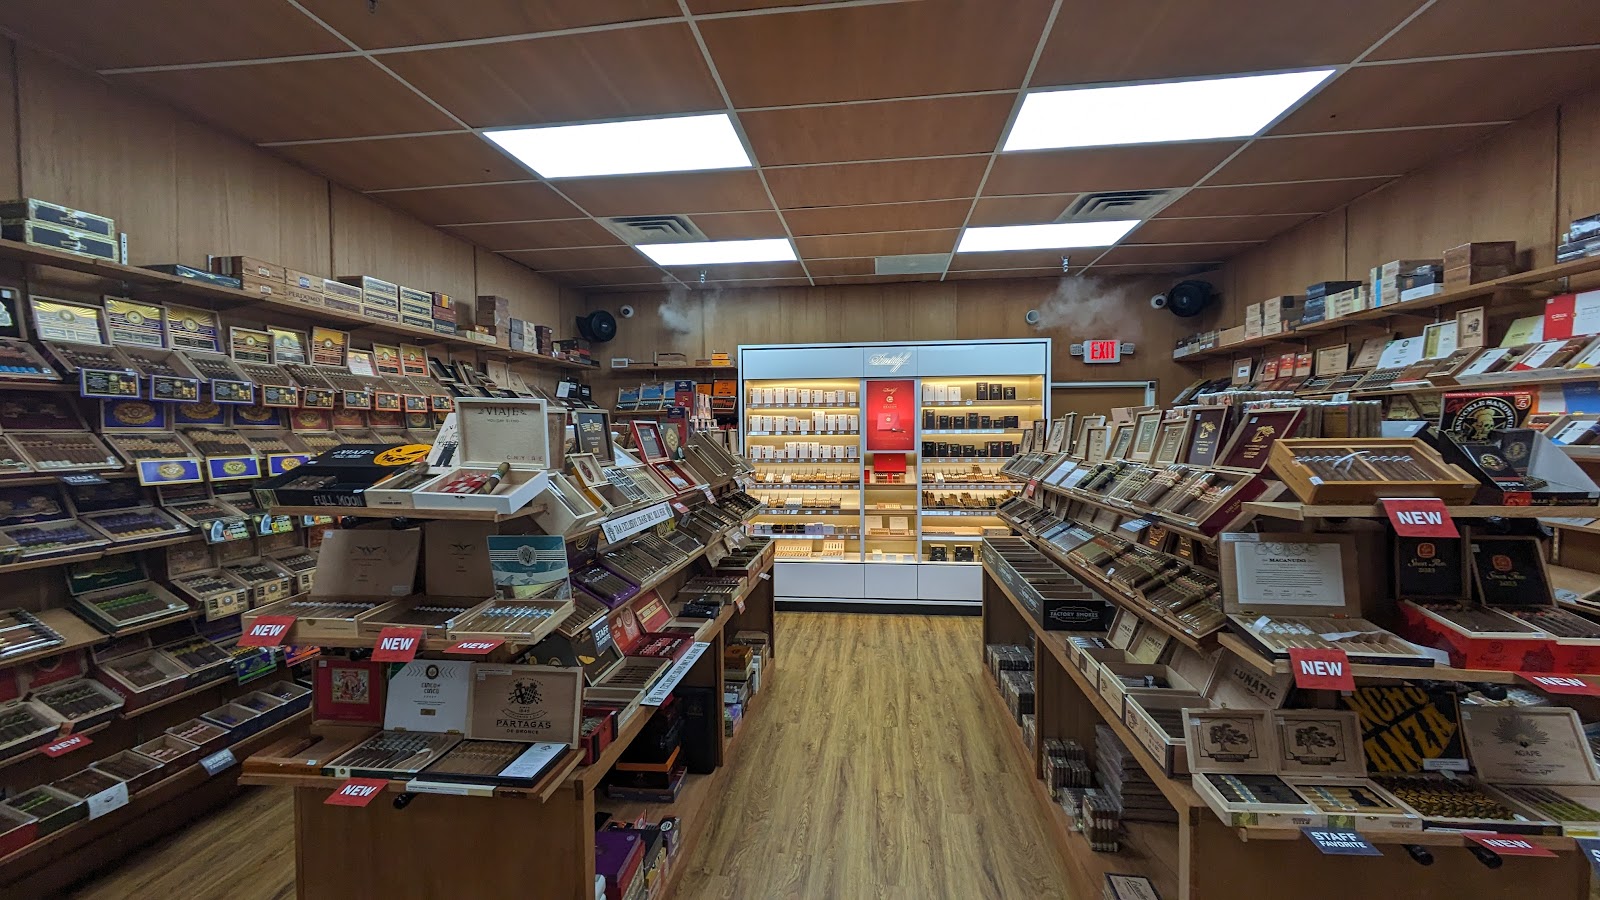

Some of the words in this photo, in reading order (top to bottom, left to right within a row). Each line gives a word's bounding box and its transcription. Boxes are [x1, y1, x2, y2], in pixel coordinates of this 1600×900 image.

[1090, 341, 1116, 359] EXIT
[485, 406, 520, 417] VIAJE
[1455, 400, 1485, 432] KNUCKLE
[313, 495, 336, 506] FULL
[336, 494, 363, 506] MOON
[1396, 511, 1443, 525] NEW
[250, 624, 285, 637] NEW
[595, 624, 609, 641] STAFF
[380, 637, 415, 650] NEW
[1300, 660, 1343, 676] NEW
[1234, 668, 1277, 700] LUNATIC
[1533, 676, 1588, 687] NEW
[496, 719, 552, 729] PARTAGAS
[49, 736, 82, 752] NEW
[1363, 703, 1458, 773] ANZA
[206, 751, 228, 766] STAFF
[340, 784, 377, 797] NEW
[1310, 832, 1357, 842] STAFF
[1482, 838, 1533, 849] NEW
[1319, 840, 1368, 849] FAVORITE
